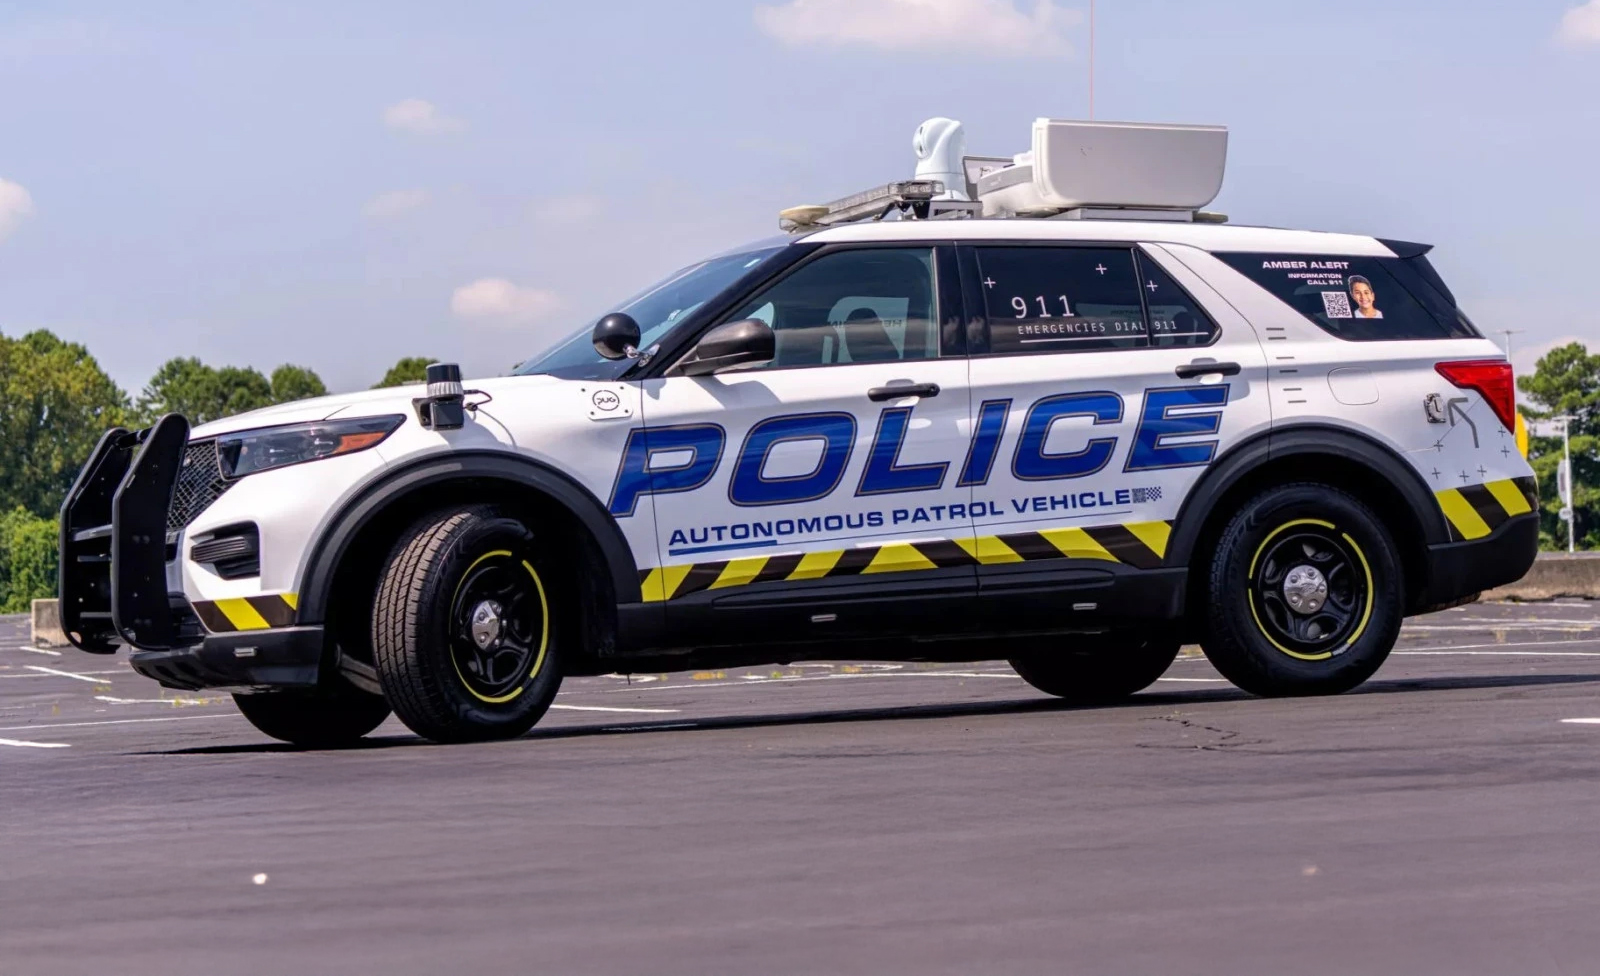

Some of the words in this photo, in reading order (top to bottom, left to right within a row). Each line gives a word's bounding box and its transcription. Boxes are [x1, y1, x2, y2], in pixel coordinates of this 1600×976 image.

[1262, 261, 1307, 269] AMBER
[1310, 261, 1349, 270] ALERT
[1011, 294, 1075, 319] 911
[1017, 322, 1106, 335] EMERGENCIES
[1114, 320, 1146, 332] DIAL
[1154, 320, 1178, 331] 911
[608, 383, 1231, 518] POLICE
[669, 511, 885, 546] AUTONOMOUS
[892, 501, 1004, 525] PATROL
[1011, 489, 1131, 513] VEHICLE
